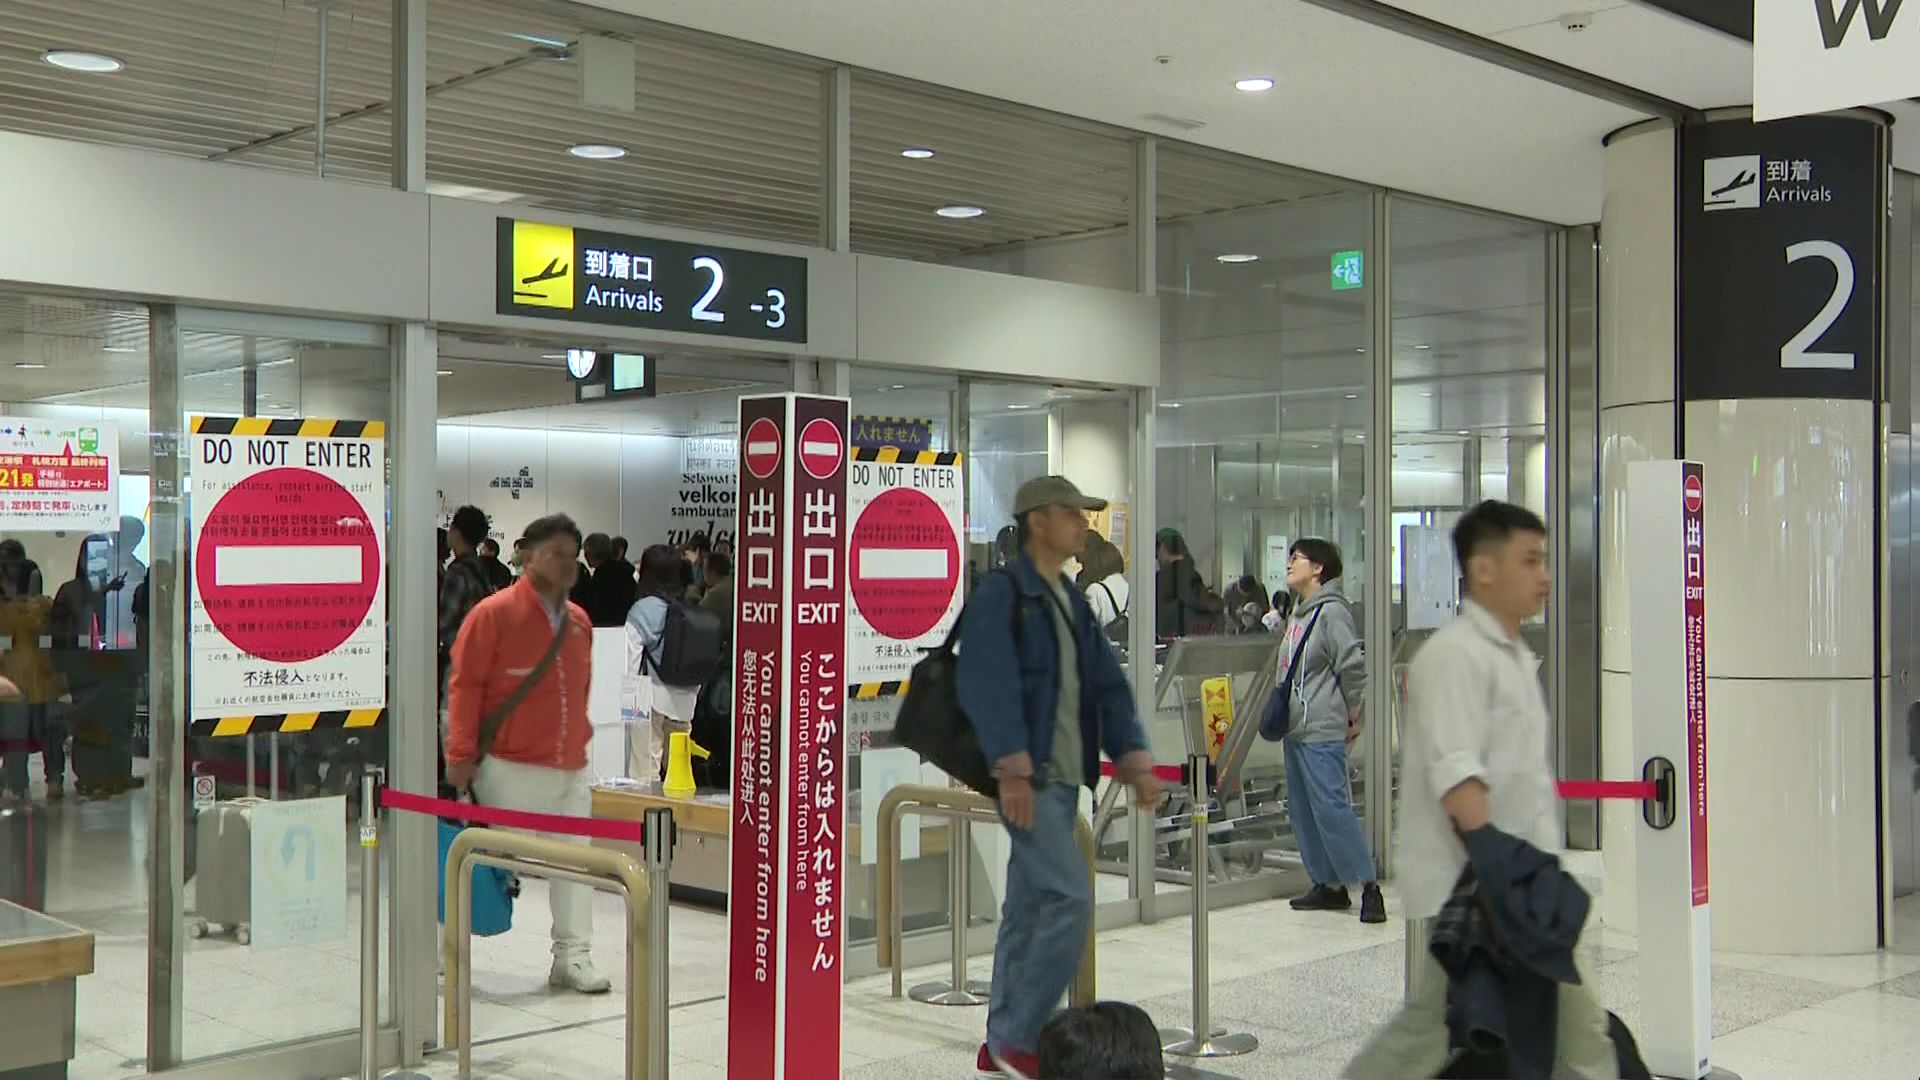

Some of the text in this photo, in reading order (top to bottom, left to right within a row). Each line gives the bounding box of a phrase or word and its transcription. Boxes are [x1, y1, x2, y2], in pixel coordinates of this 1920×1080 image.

[1766, 160, 1812, 183] 到着
[1766, 186, 1832, 202] Arrivals
[584, 249, 653, 282] 到着口
[585, 285, 663, 313] Arrivals
[691, 257, 725, 322] 2
[1780, 240, 1856, 370] 2
[203, 438, 232, 464] DO
[248, 440, 289, 466] NOT
[305, 441, 372, 468] ENTER
[852, 465, 955, 489] DO NOT ENTER
[679, 484, 736, 504] velko
[747, 488, 776, 590] 出口
[803, 488, 837, 590] 出口
[1687, 517, 1701, 579] 出口
[1686, 586, 1703, 600] EXIT
[742, 601, 779, 624] EXIT
[798, 603, 840, 624] EXIT
[796, 651, 812, 892] You cannot enter from here
[755, 651, 775, 983] You cannot enter from here
[811, 653, 837, 972] ここからは入れません
